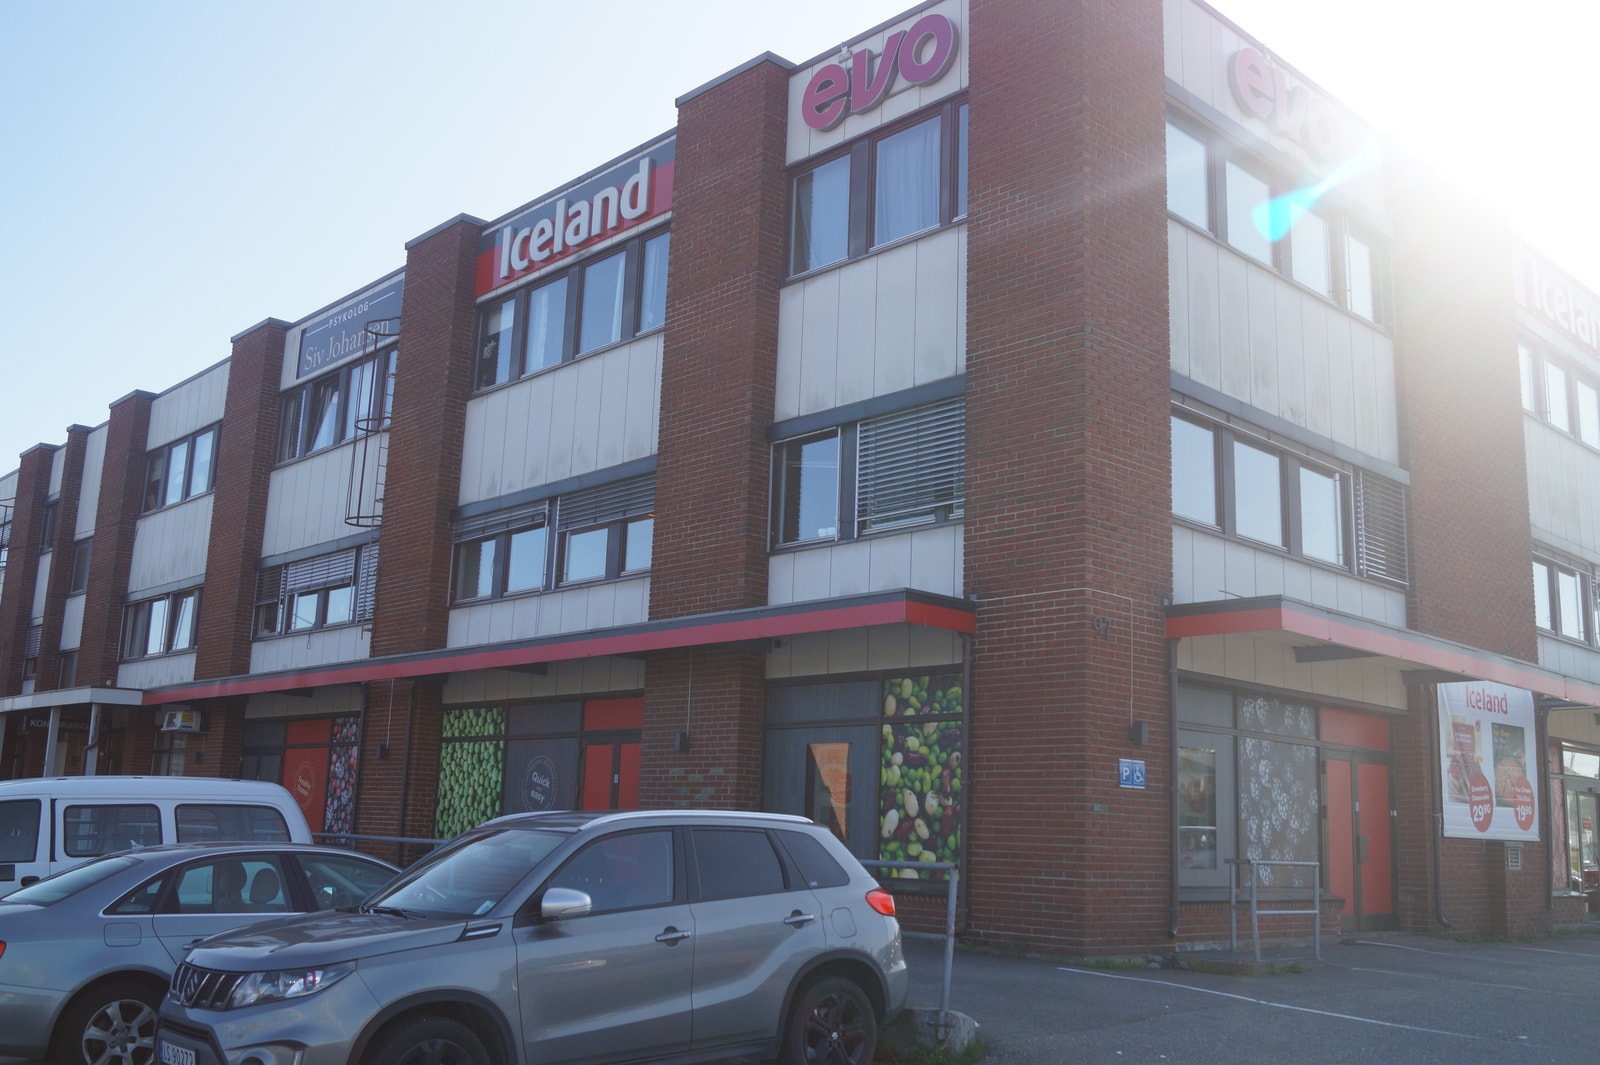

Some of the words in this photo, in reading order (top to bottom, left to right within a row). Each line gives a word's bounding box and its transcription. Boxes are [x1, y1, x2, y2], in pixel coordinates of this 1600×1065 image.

[802, 14, 958, 131] evo
[1227, 47, 1344, 165] evo
[500, 157, 654, 279] Iceland
[328, 301, 369, 329] PSYKOLOG
[304, 346, 325, 371] Siv
[326, 320, 390, 361] Johansen
[1092, 615, 1111, 641] 97
[1465, 684, 1508, 715] Iceland
[532, 771, 551, 789] Quick
[1121, 765, 1130, 781] P
[530, 789, 546, 804] easy
